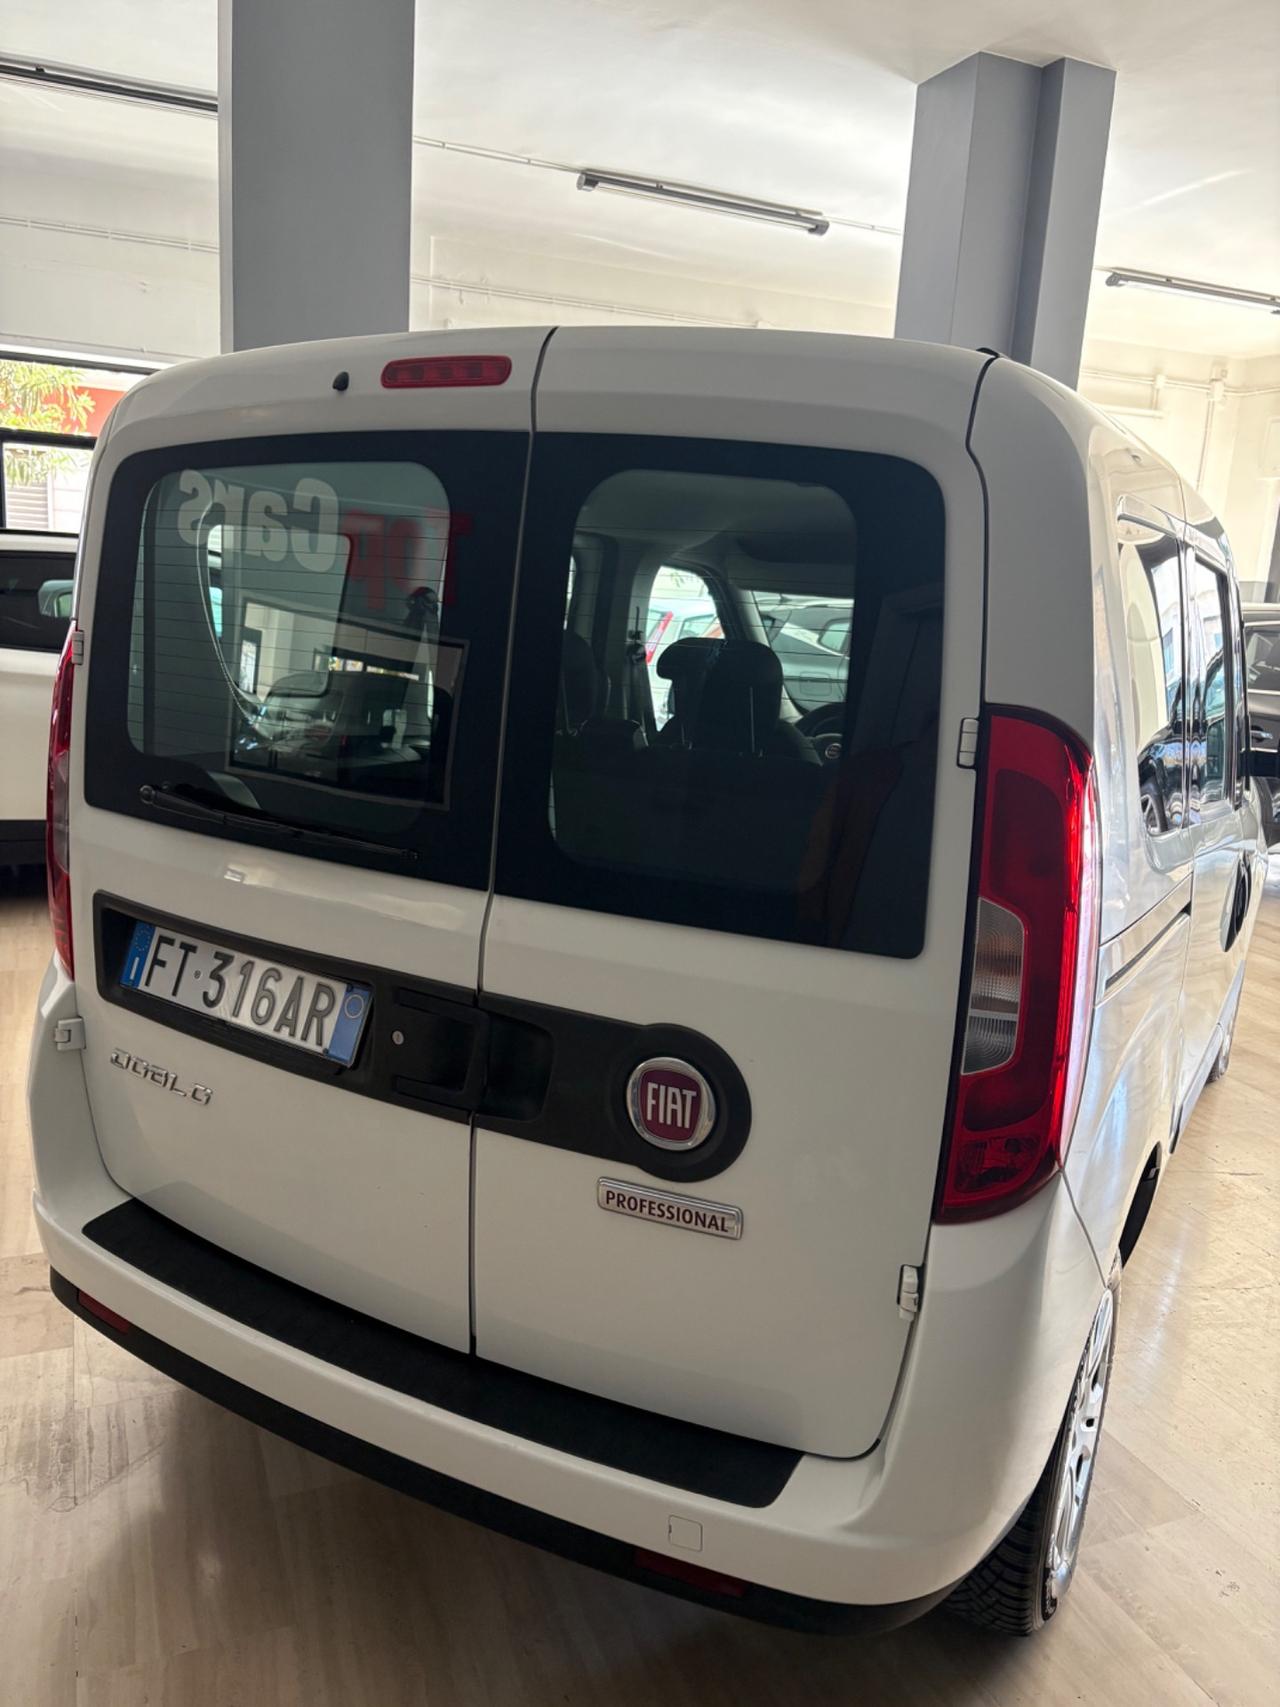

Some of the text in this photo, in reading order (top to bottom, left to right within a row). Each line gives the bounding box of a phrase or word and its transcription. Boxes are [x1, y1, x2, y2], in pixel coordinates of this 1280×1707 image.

[145, 935, 337, 1048] FT 316AR
[647, 1082, 697, 1129] FIAT
[605, 1190, 730, 1233] PROFESSIONAL
